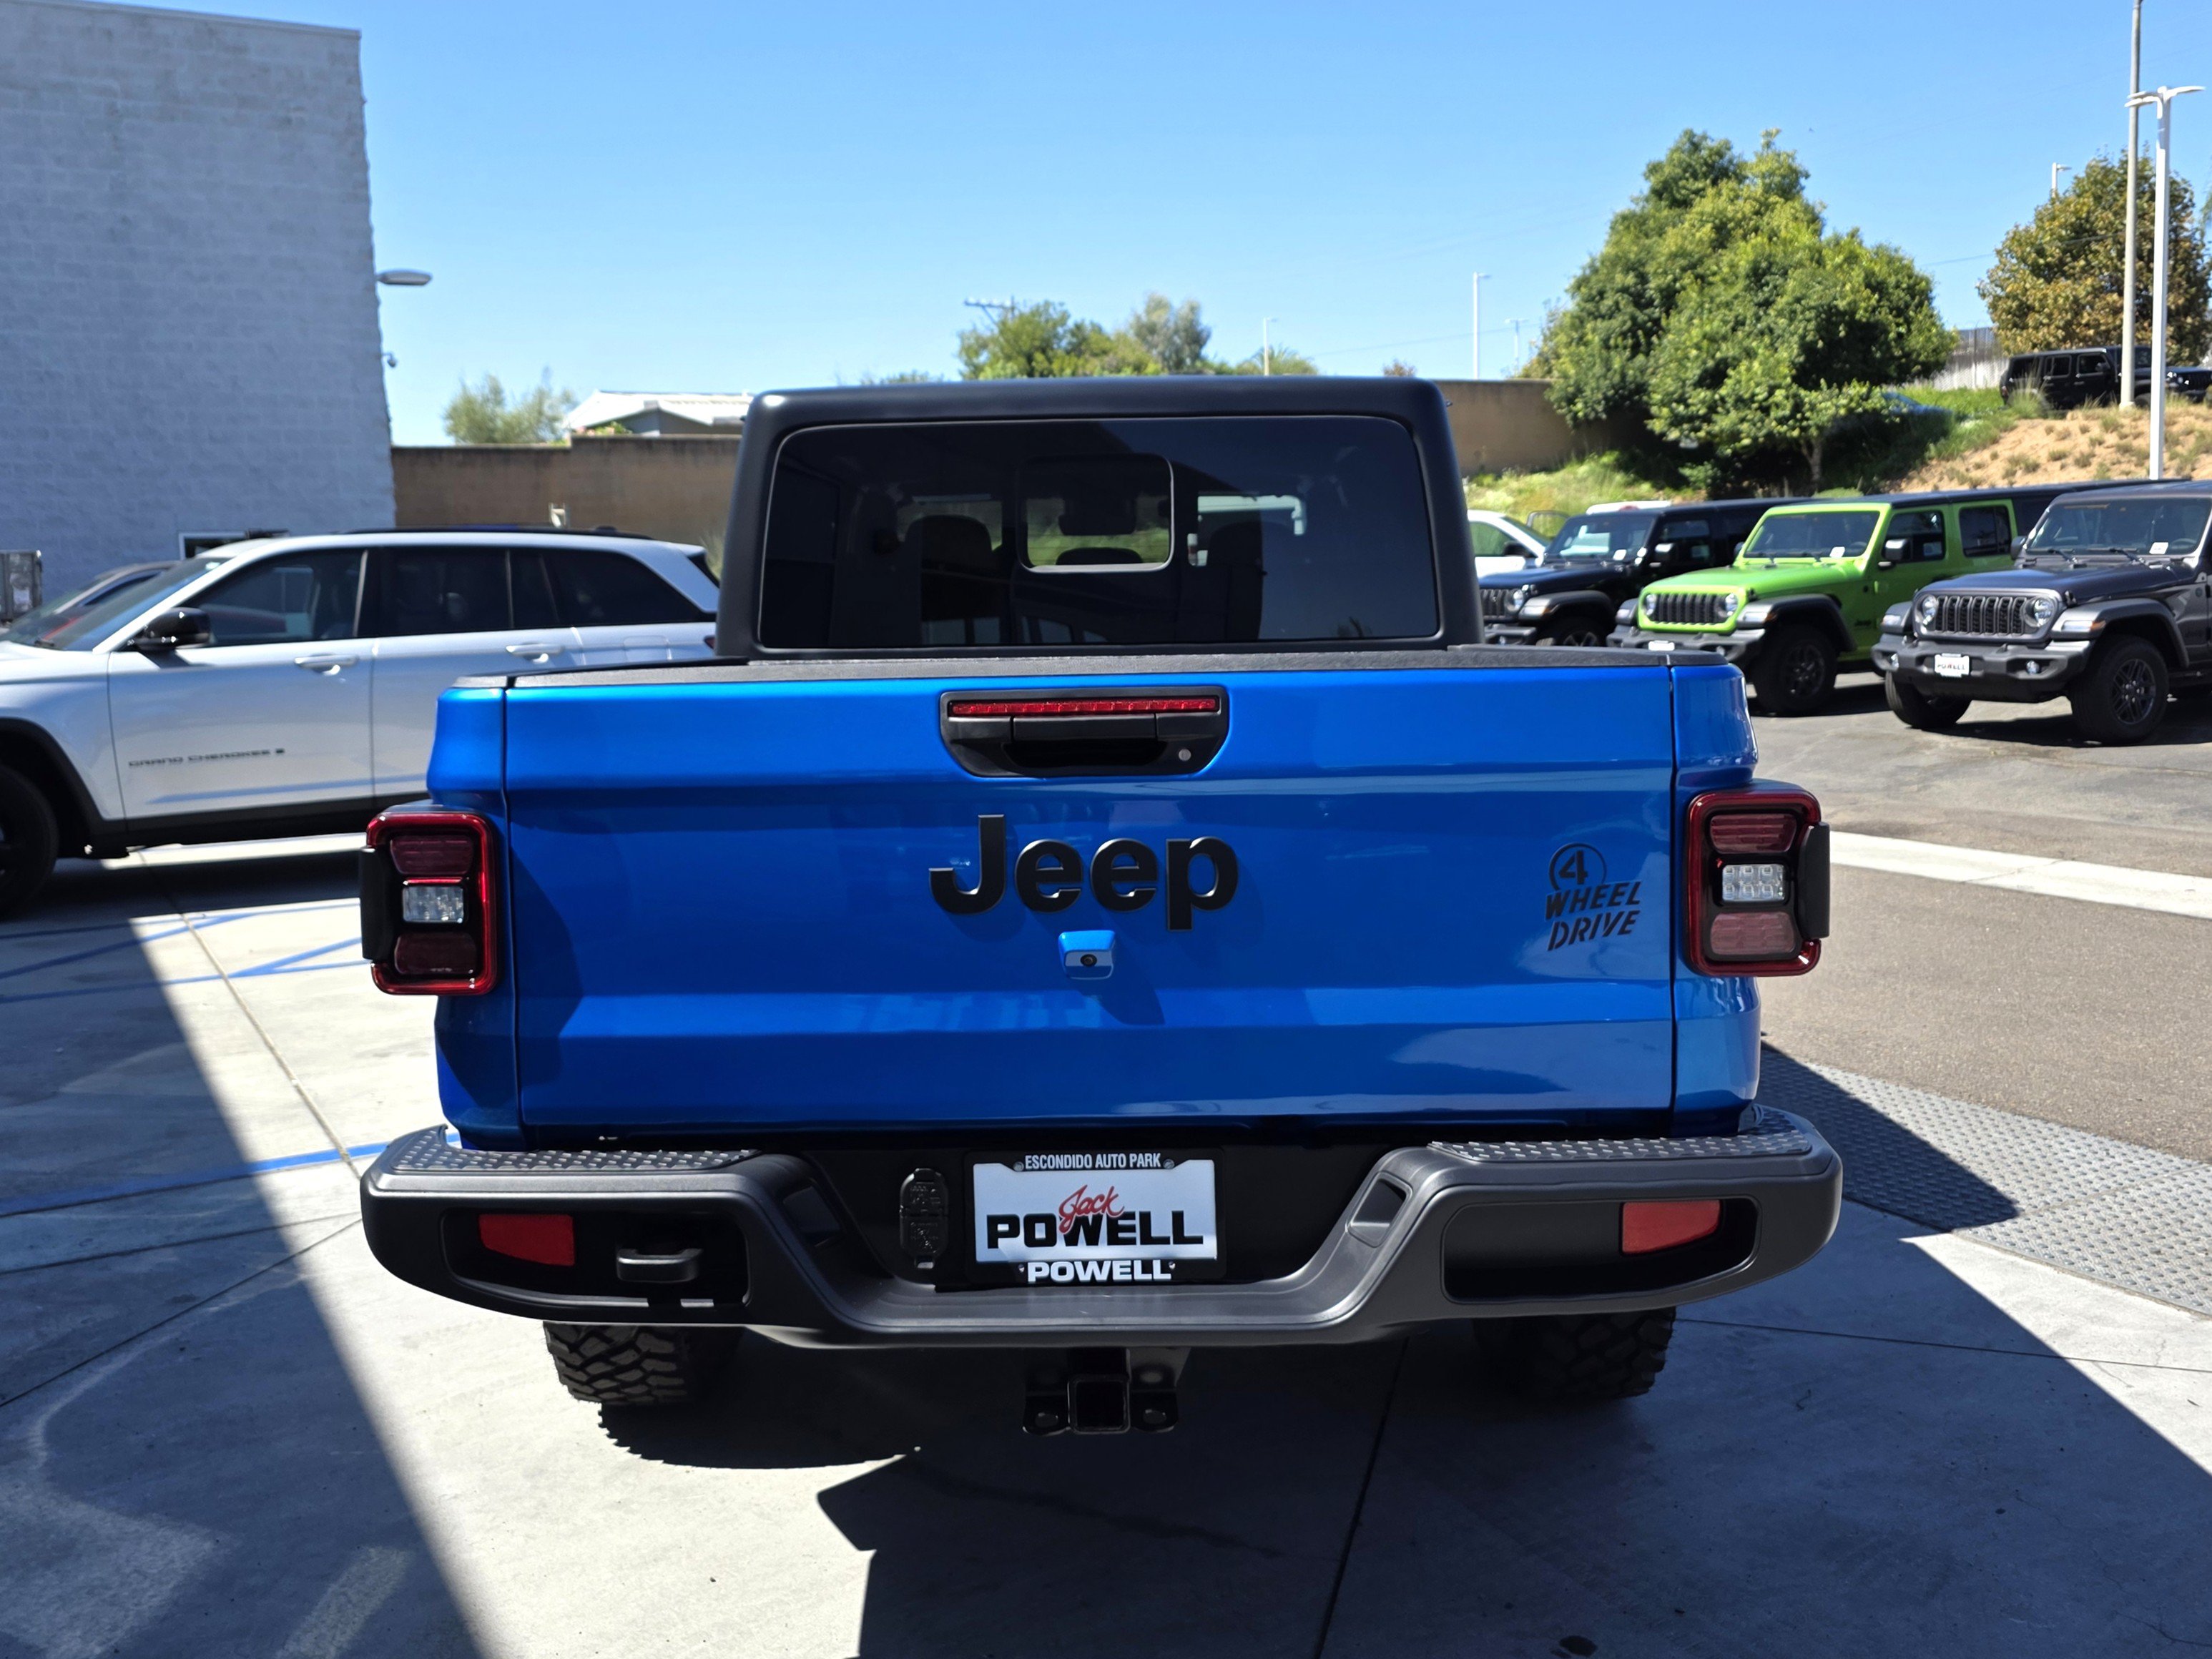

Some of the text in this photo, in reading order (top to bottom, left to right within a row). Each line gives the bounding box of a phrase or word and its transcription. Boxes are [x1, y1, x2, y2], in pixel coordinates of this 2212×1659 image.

[129, 756, 183, 767] GRAND
[187, 749, 271, 762] CHEROKEE
[928, 814, 1239, 931] Jeep
[1558, 850, 1588, 885] 4
[1545, 881, 1642, 920] WHEEL
[1547, 910, 1641, 951] DRIVE
[1024, 1153, 1161, 1170] ESCONDIDO AUTO PARK
[1058, 1184, 1125, 1234] Jack
[986, 1210, 1204, 1249] POWELL
[1027, 1259, 1172, 1284] POWELL
